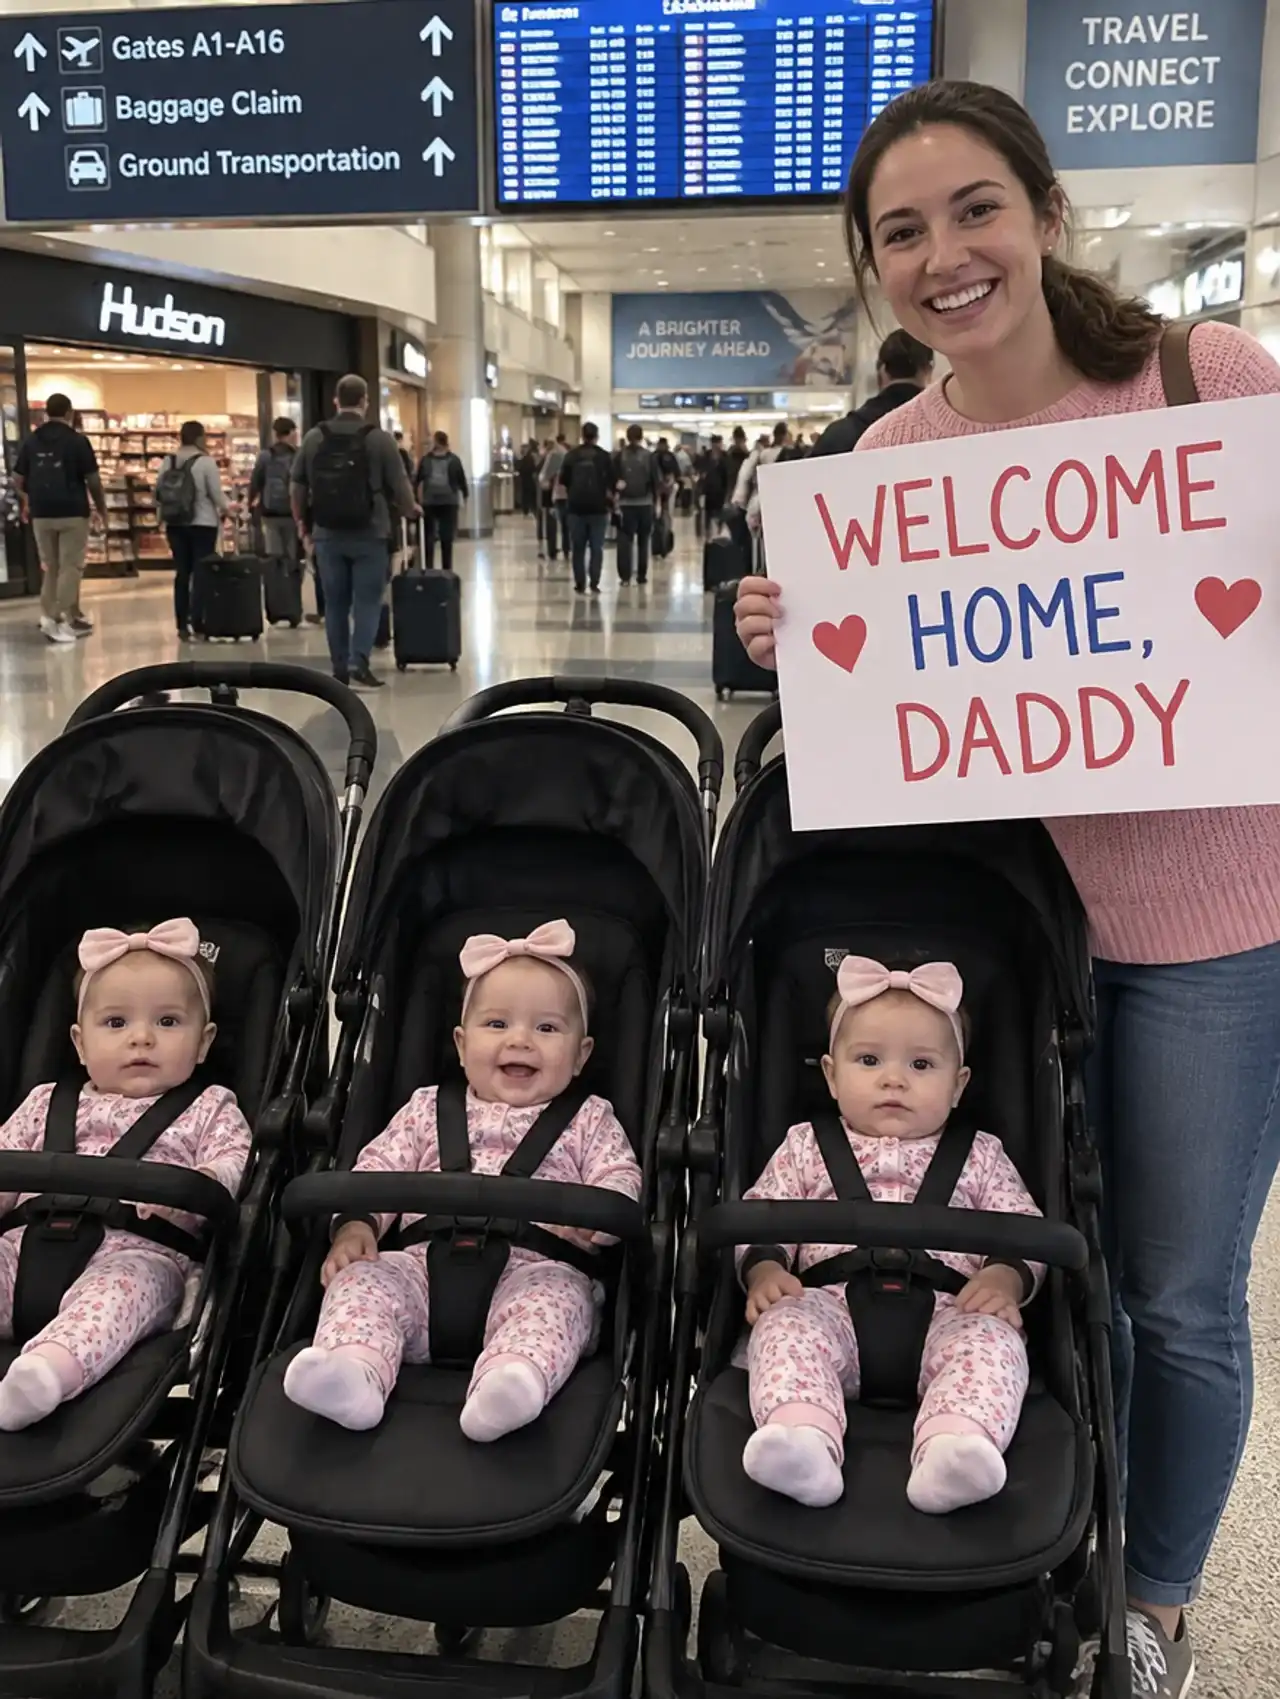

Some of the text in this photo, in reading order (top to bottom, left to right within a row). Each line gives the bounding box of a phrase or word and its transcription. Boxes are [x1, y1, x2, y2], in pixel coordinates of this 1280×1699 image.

[112, 29, 285, 61] Gates A1-A16
[1082, 13, 1208, 45] TRAVEL
[1065, 56, 1220, 90] CONNECT
[116, 89, 302, 125] Baggage Claim
[1066, 100, 1215, 134] EXPLORE
[119, 146, 400, 178] Ground Transportation
[100, 282, 225, 346] Hudson
[638, 319, 741, 337] A BRIGHTER
[626, 340, 771, 359] JOURNEY AHEAD
[814, 441, 1227, 571] WELCOME
[908, 571, 1154, 671] HOME,
[896, 679, 1190, 782] DADDY
